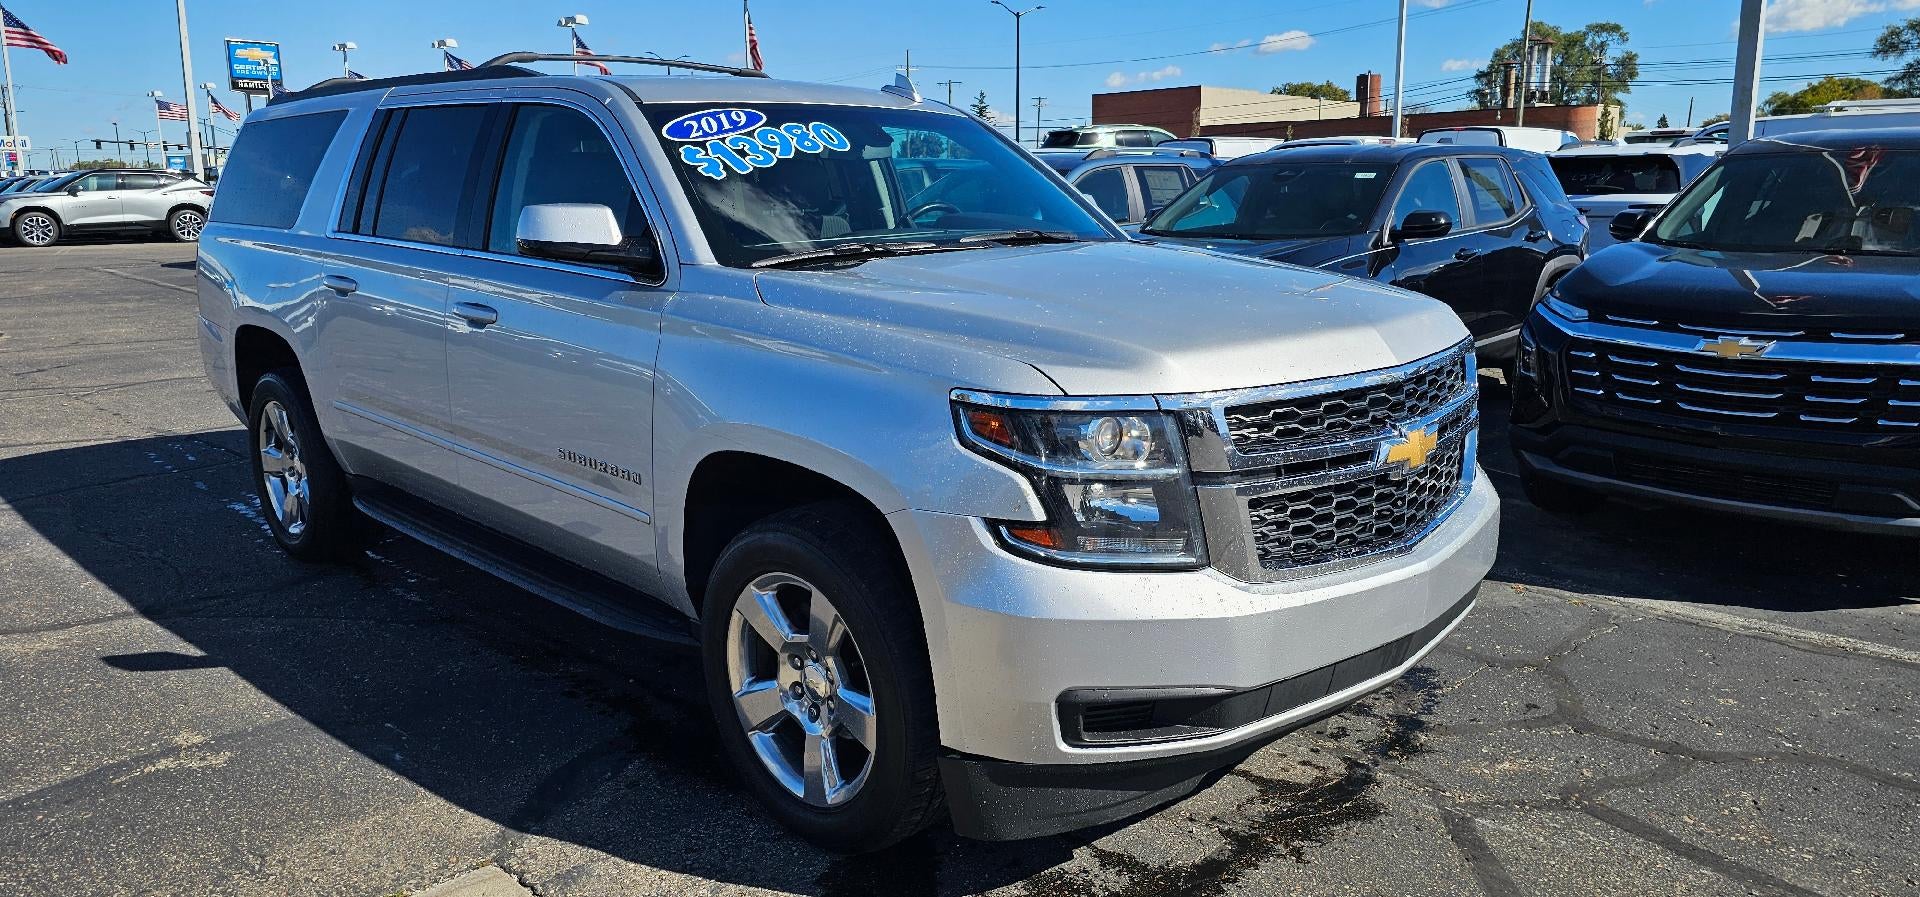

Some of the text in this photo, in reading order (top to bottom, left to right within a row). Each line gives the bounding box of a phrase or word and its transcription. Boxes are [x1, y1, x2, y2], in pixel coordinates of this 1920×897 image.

[233, 64, 278, 72] CERTIFID
[238, 81, 271, 89] HAMILTO
[684, 110, 747, 139] 2019
[679, 122, 850, 180] $13980
[557, 447, 642, 486] SUBURBAN
